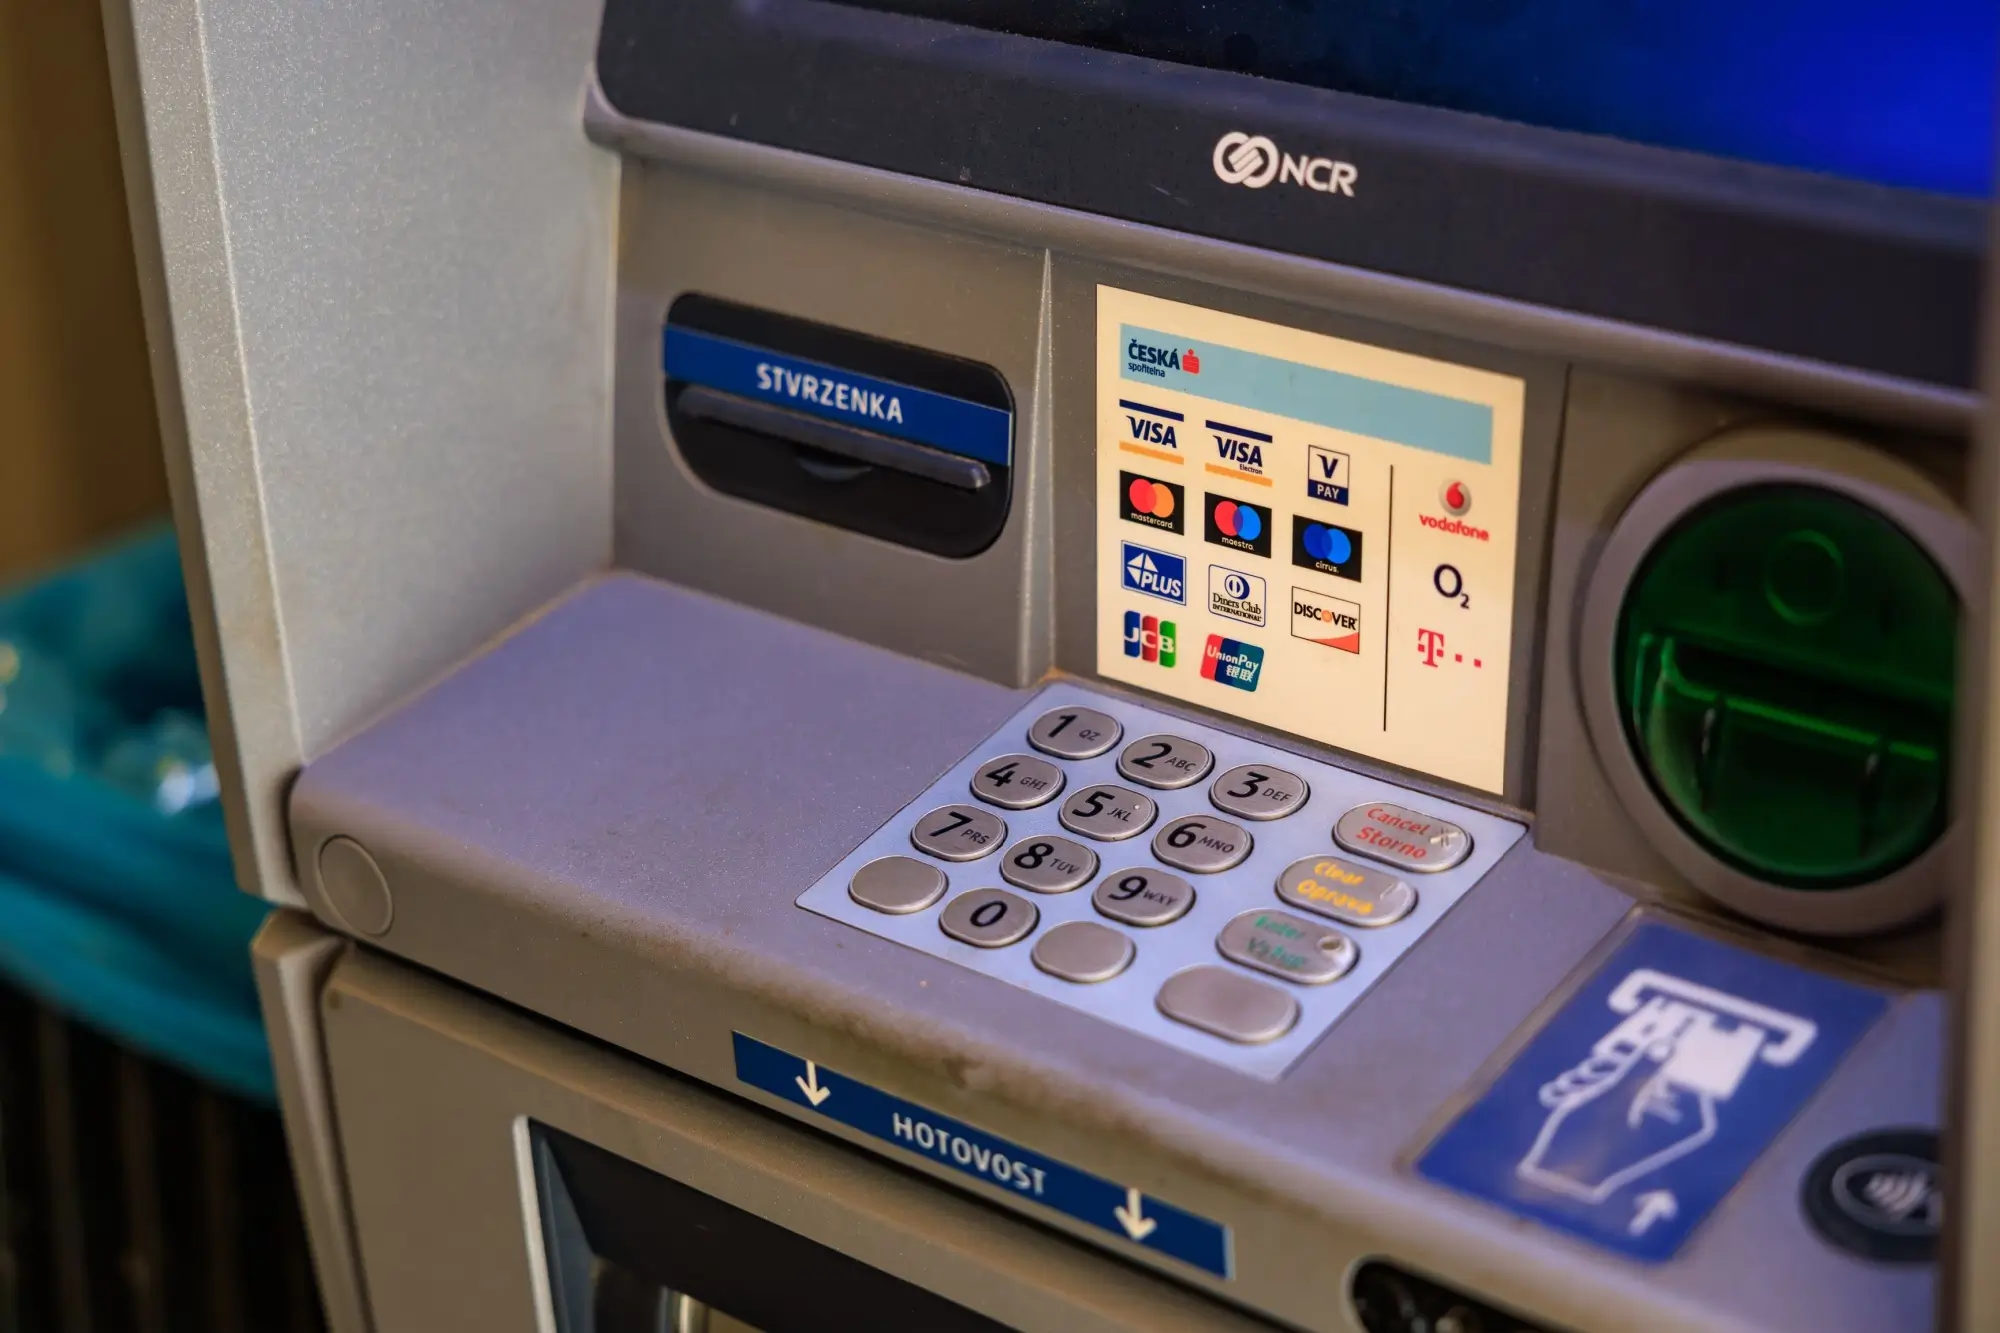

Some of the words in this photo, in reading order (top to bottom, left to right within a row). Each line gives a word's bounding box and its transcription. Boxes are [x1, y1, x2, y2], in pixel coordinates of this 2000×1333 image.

[1279, 152, 1358, 197] NCR
[1128, 338, 1180, 370] ČESKÁ
[1128, 362, 1165, 377] spořitelna
[756, 362, 903, 424] STVRZENKA
[1126, 415, 1177, 449] VISA
[1213, 434, 1263, 467] VISA
[1239, 464, 1263, 475] Electron
[1316, 453, 1339, 479] V
[1317, 483, 1340, 500] PAY
[1130, 512, 1173, 529] mastercard
[1418, 513, 1490, 542] vodafone
[1221, 536, 1254, 551] maestro
[1315, 560, 1338, 573] cirrus
[1141, 572, 1182, 597] PLUS
[1212, 593, 1240, 609] Diners
[1241, 600, 1262, 615] Club
[1212, 604, 1262, 622] INTERNATIONAL
[1294, 602, 1357, 631] DISCOVER
[1124, 626, 1174, 654] JCB
[1206, 645, 1259, 675] UnionPay
[1226, 664, 1254, 683] 银联
[1048, 714, 1078, 738] 1
[1078, 729, 1101, 742] QZ
[1130, 742, 1172, 769] 2
[1164, 756, 1197, 773] ABC
[985, 762, 1020, 788] 4
[1019, 776, 1048, 791] GHI
[1226, 771, 1270, 798] 3
[1261, 787, 1293, 802] DEF
[1072, 790, 1115, 818] 5
[1106, 807, 1132, 822] JKL
[929, 811, 974, 837] 7
[961, 828, 991, 844] PRS
[1367, 807, 1431, 836] Cancel
[1166, 823, 1207, 848] 6
[1198, 835, 1235, 854] MNO
[1356, 827, 1427, 860] Storno
[1013, 842, 1055, 869] 8
[1050, 858, 1081, 874] TUV
[1314, 861, 1365, 886] Clear
[1107, 875, 1148, 900] 9
[1142, 890, 1179, 906] WXY
[1297, 879, 1374, 915] Oprava
[970, 900, 1008, 928] 0
[892, 1112, 1047, 1196] HOTOVOST
